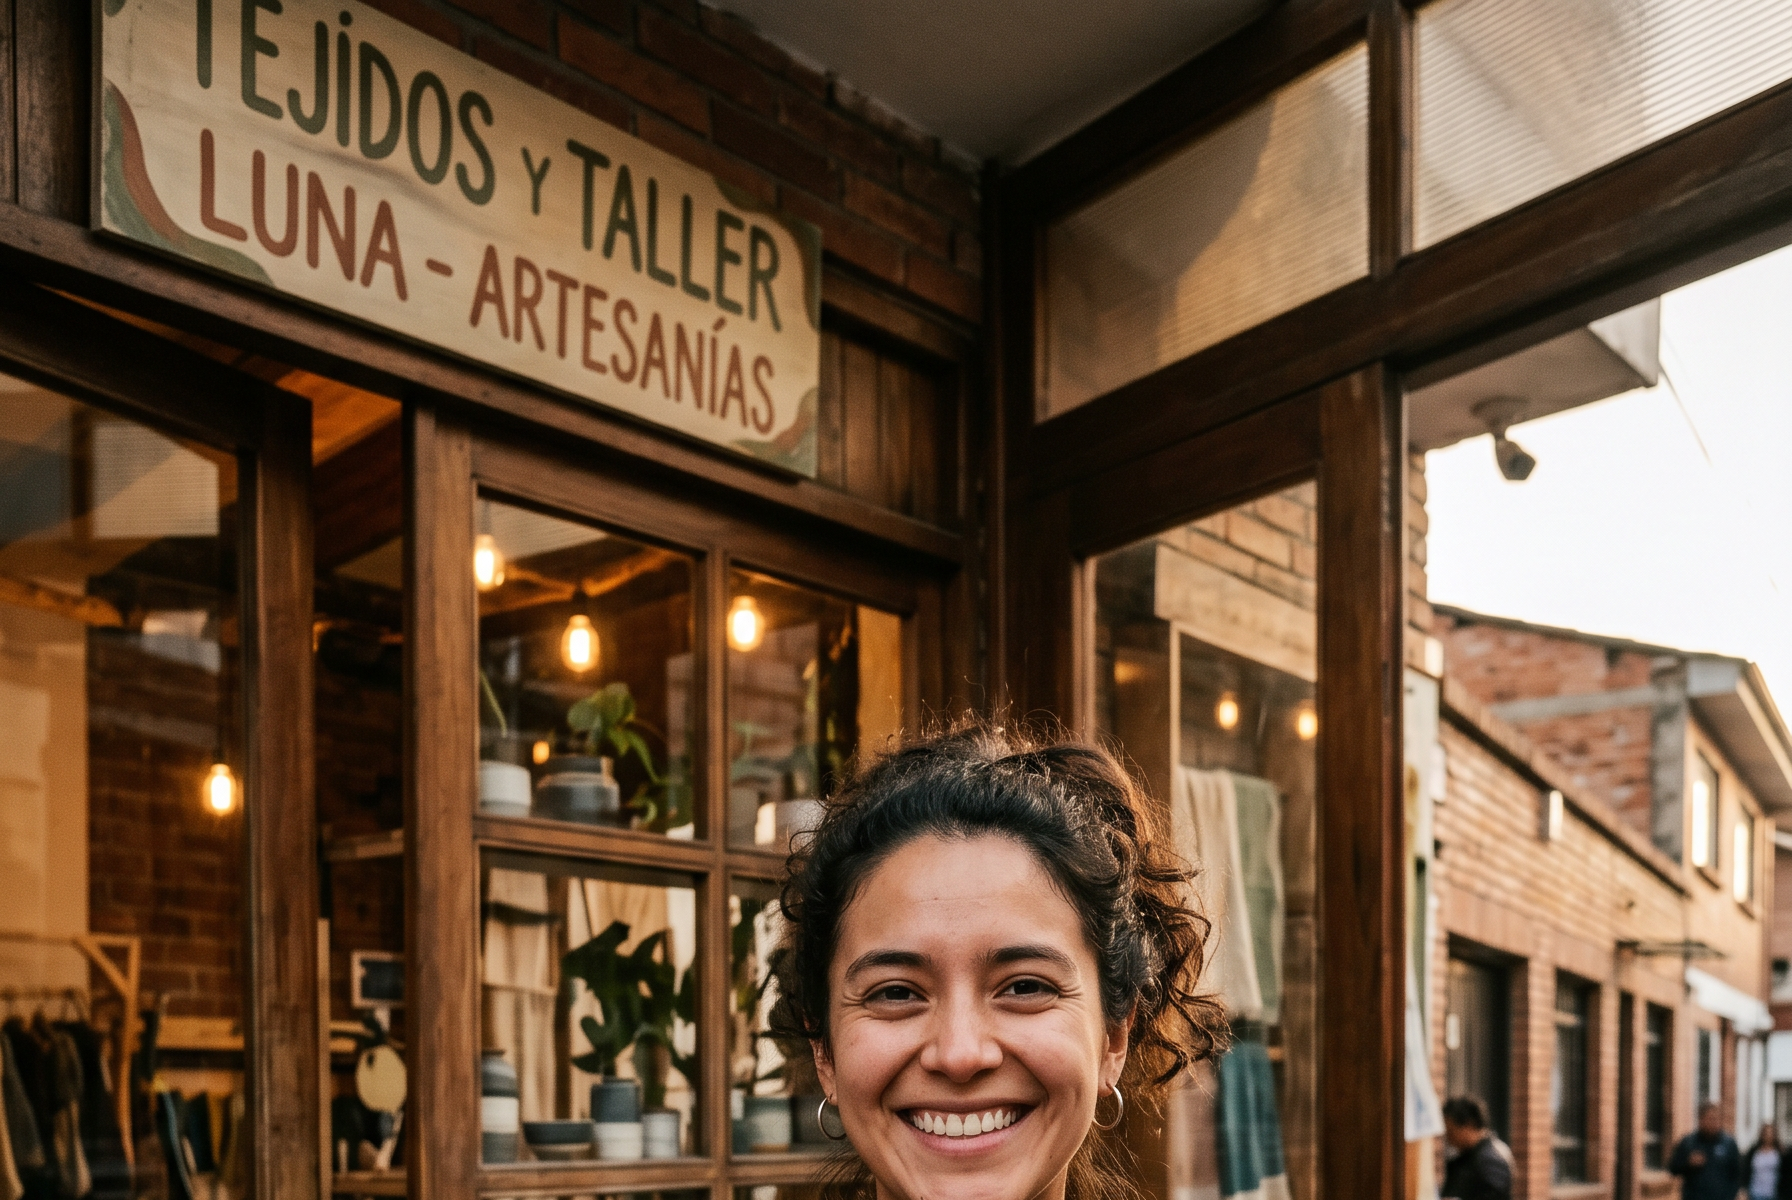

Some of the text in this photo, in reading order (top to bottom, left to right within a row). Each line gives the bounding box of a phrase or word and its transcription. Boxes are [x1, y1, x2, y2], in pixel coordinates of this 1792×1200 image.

[200, 128, 408, 302] LUNA
[469, 244, 774, 435] ARTESANÍAS
[521, 147, 551, 215] Y
[566, 139, 782, 332] TALLER
